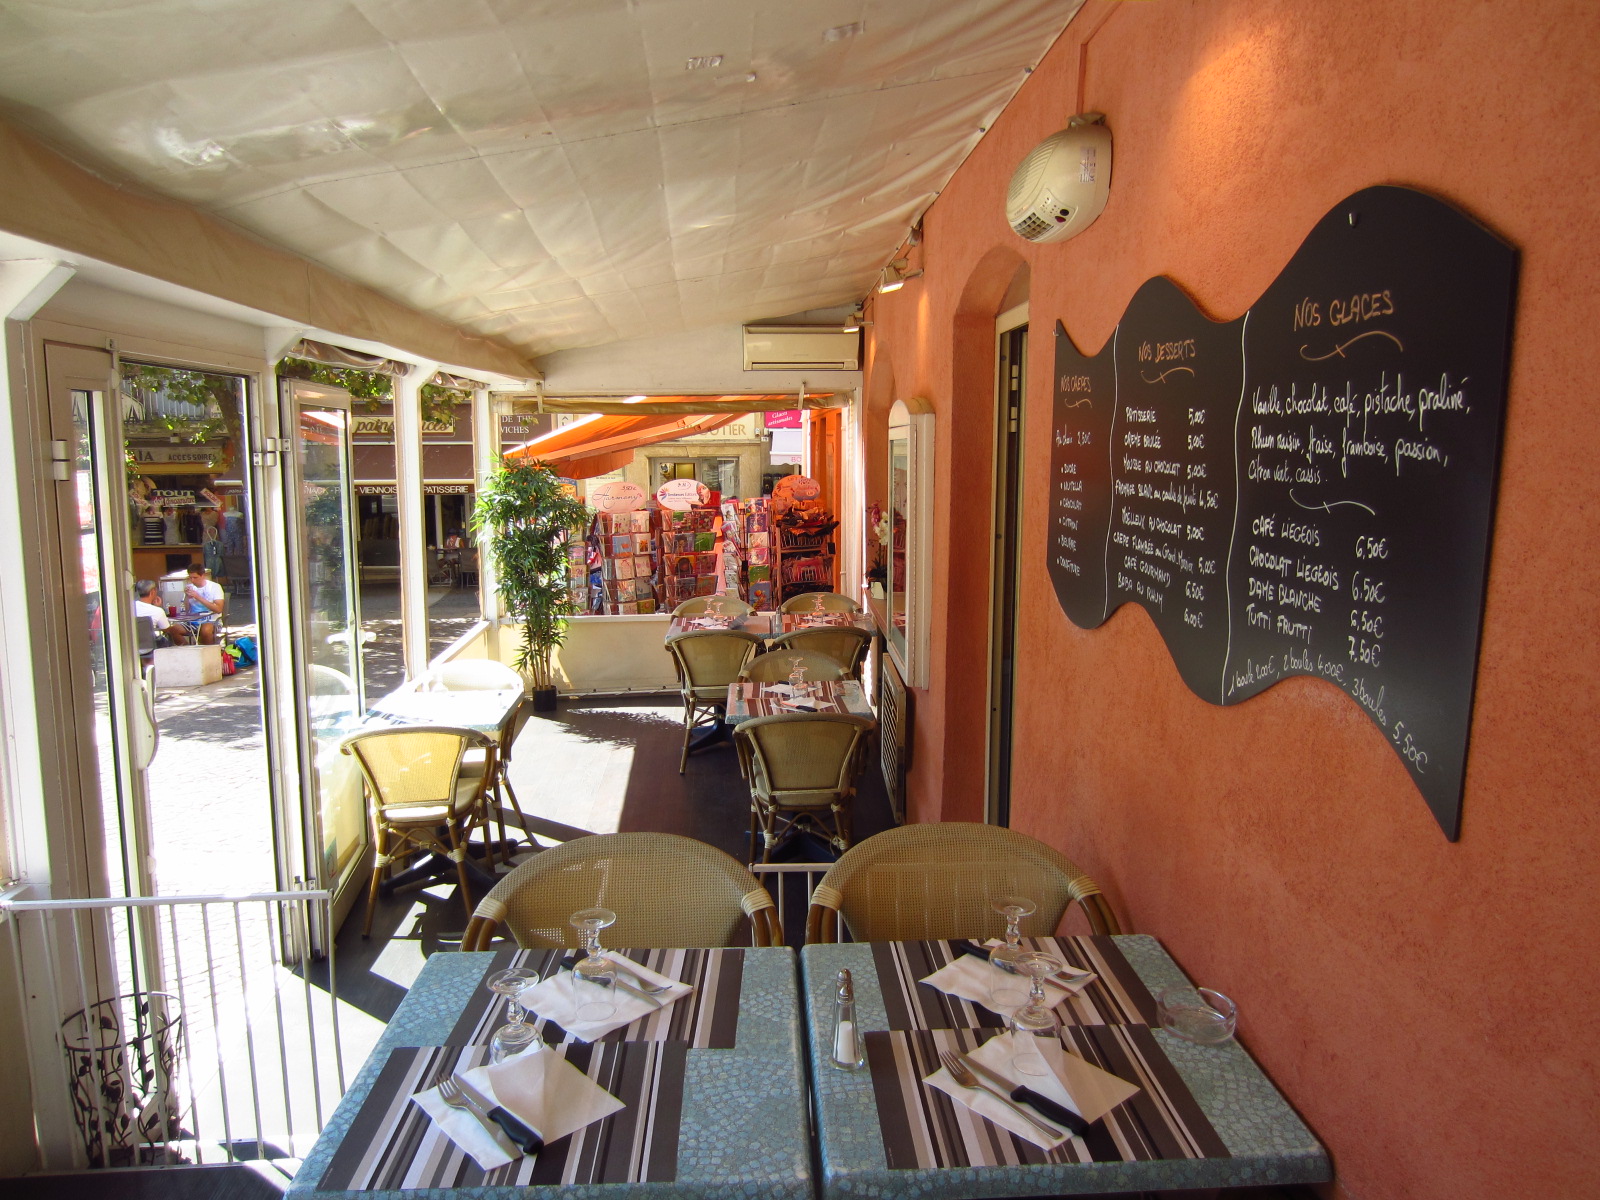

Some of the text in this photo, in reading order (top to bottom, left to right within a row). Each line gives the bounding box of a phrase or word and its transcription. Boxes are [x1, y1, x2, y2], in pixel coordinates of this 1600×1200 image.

[1293, 290, 1394, 332] NOS GLACES
[1138, 339, 1196, 364] NOS DESSERTS
[354, 418, 394, 434] pains
[1252, 424, 1274, 449] Rhum
[1154, 460, 1180, 476] CHOCOLAT
[1248, 454, 1271, 483] Citron
[424, 486, 468, 494] PATISSERIE
[592, 486, 640, 509] Harmony
[1156, 518, 1182, 538] CHOCOLAT
[1252, 513, 1275, 538] CAFÉ
[1356, 536, 1388, 560] 6,50€
[1250, 546, 1292, 578] CHOCOLAT
[1248, 578, 1274, 602] DAME
[1278, 584, 1322, 613] BLANCHE
[1392, 721, 1428, 774] 5,50€
